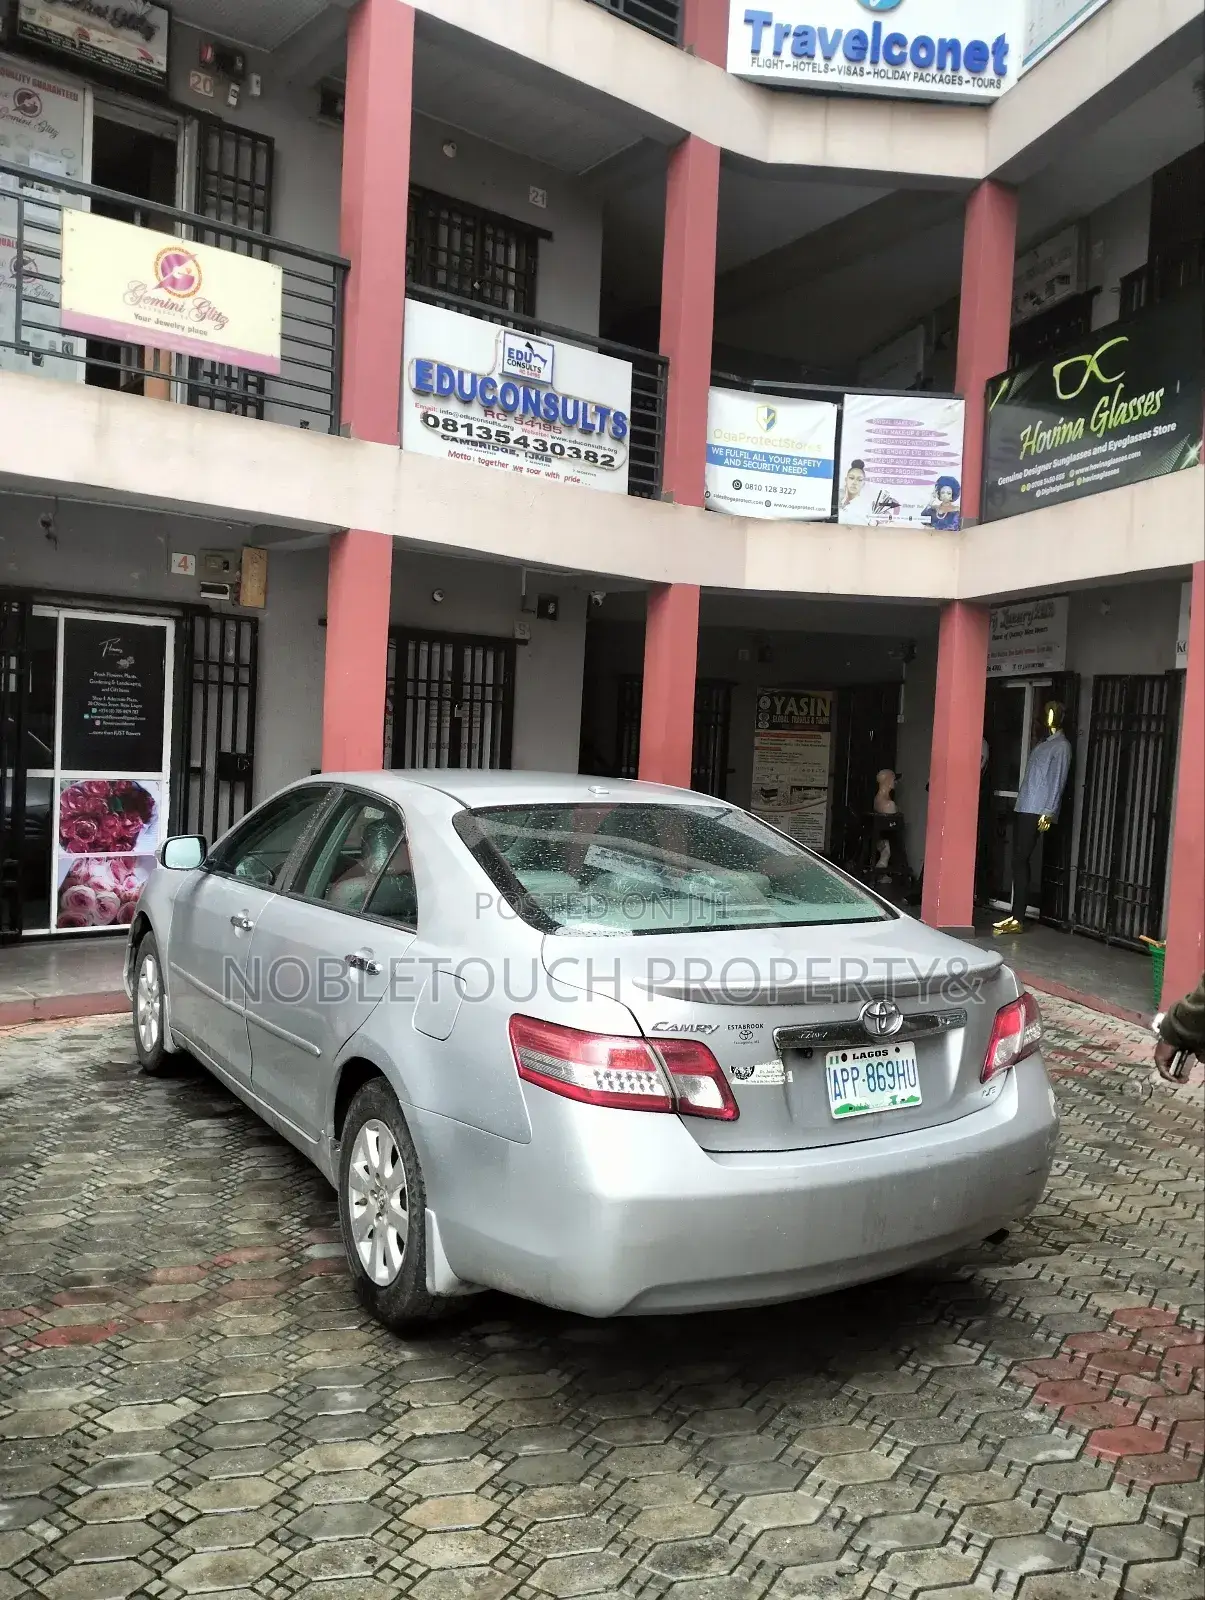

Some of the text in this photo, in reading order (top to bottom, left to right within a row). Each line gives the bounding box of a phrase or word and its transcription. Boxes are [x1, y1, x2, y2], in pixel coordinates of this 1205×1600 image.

[744, 9, 1009, 77] Travelconet
[192, 73, 213, 94] 20
[531, 190, 546, 206] 21
[123, 280, 187, 315] Gemini
[188, 297, 230, 331] Glitz
[134, 312, 152, 324] Your
[155, 317, 186, 332] Jewelry
[187, 326, 208, 337] place
[507, 358, 542, 374] CONSULTS
[508, 347, 532, 363] EDU
[412, 358, 628, 440] EDUCONSULTS
[414, 402, 515, 432] Email: info@educonsults.org
[484, 409, 563, 435] RC 54195
[1019, 382, 1165, 460] Hovina Glasses
[422, 413, 615, 468] 08135430382
[711, 446, 822, 468] WE FULFIL ALL YOUR SAFETY
[998, 421, 1177, 486] Genuine Designer Sunglasses and Eyeglasses Store
[478, 456, 509, 470] together
[513, 464, 524, 473] we
[527, 467, 541, 475] soar
[545, 470, 560, 480] with
[724, 458, 808, 475] AND SECURITY NEEDS
[745, 483, 797, 495] 0810 128 3227
[177, 555, 189, 572] 4
[773, 696, 830, 717] YASIN
[651, 1021, 720, 1035] CAMRY
[852, 1049, 889, 1060] LAGOS
